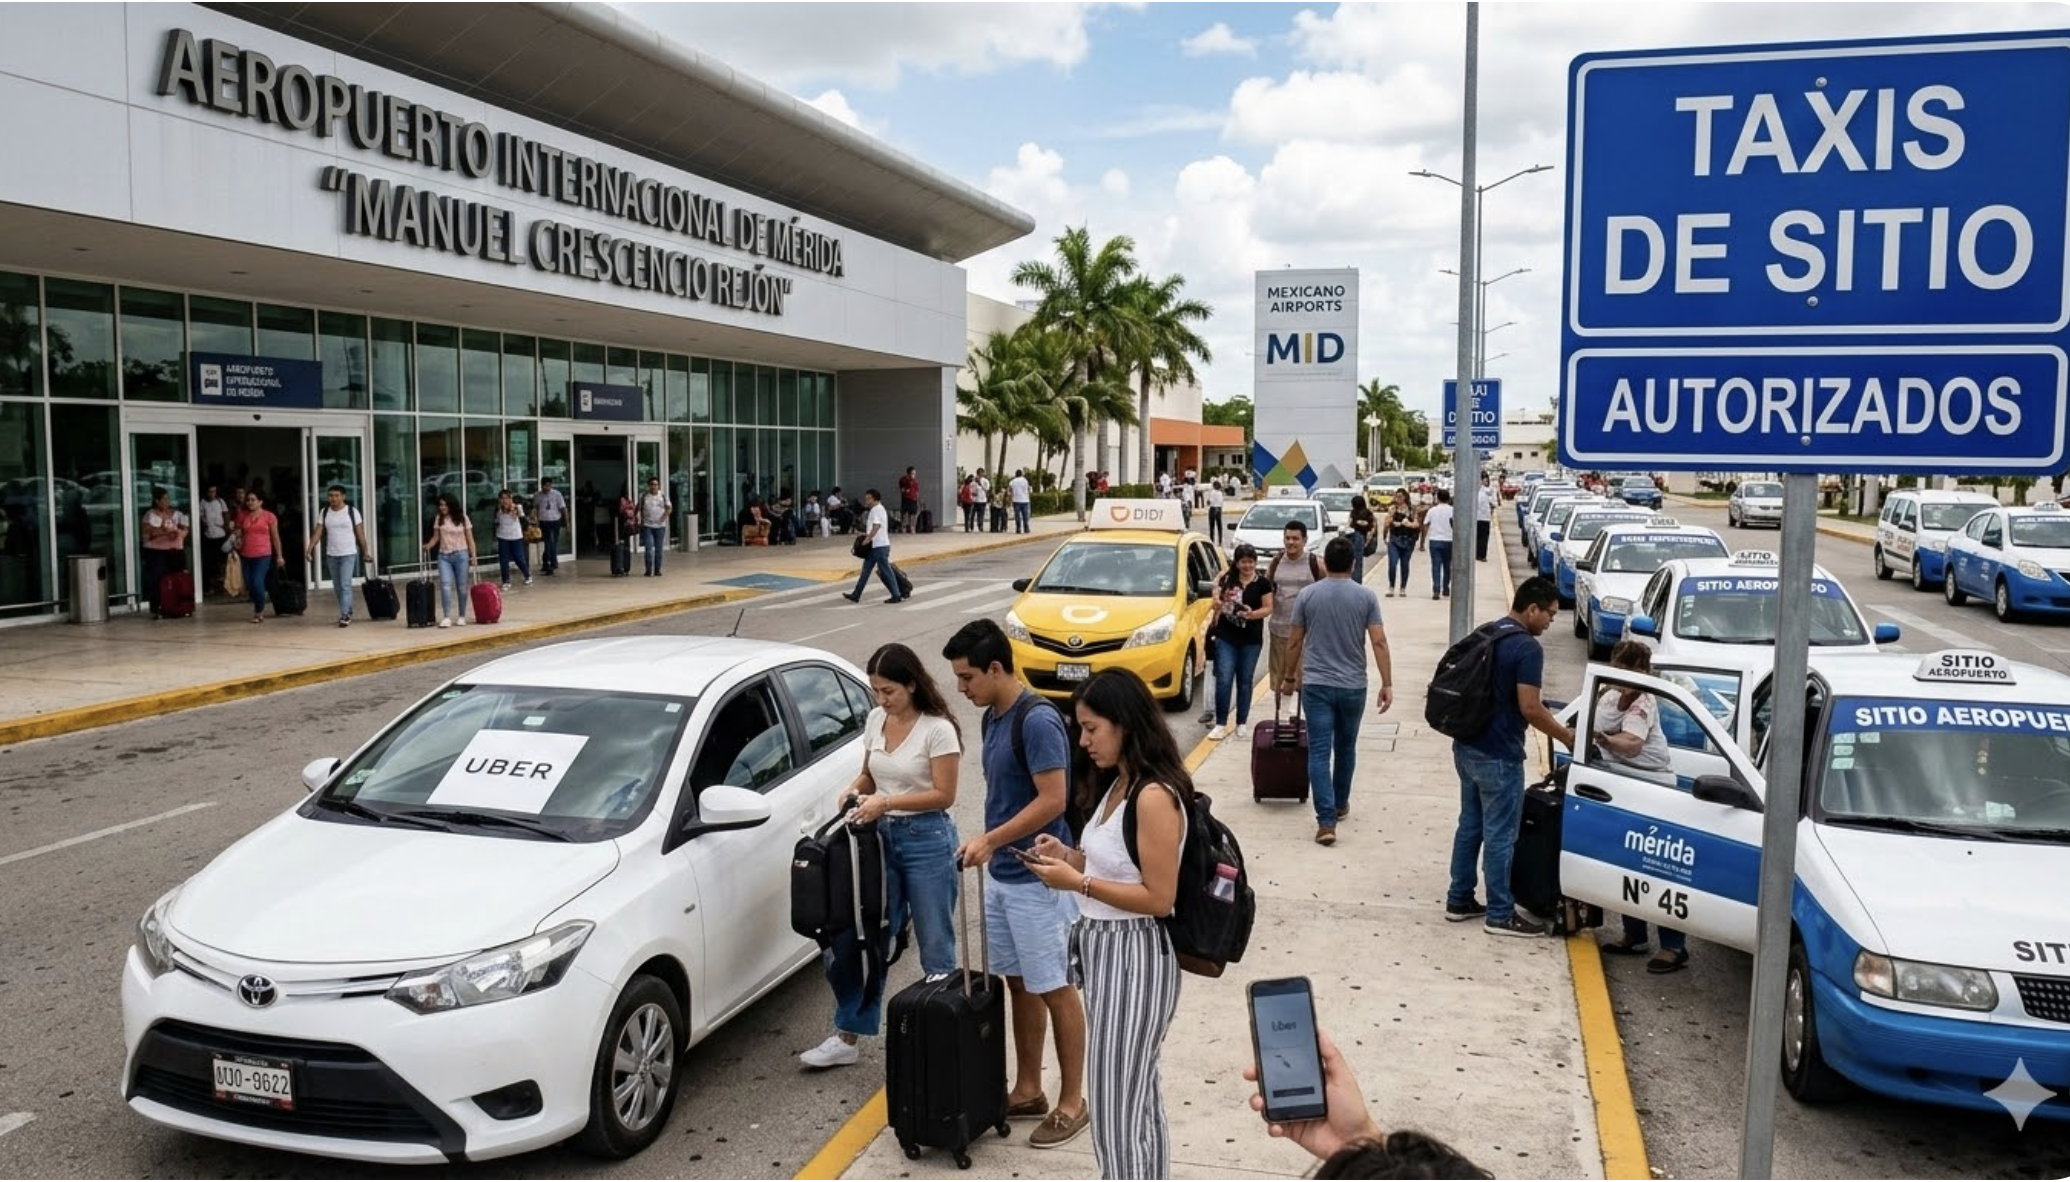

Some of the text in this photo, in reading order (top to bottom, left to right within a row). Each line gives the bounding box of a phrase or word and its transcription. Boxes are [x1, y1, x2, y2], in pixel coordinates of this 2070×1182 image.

[1675, 84, 1967, 177] TAXIS
[156, 28, 844, 276] AEROPUERTO INTERNACIONAL DE MÉRIDA
[529, 219, 712, 301] CRESCENCIO
[1604, 203, 2035, 295] DE SITIO
[1267, 285, 1346, 299] MEXICANO
[1270, 300, 1343, 313] AIRPORTS
[1266, 332, 1345, 365] MID
[1602, 376, 2023, 436] AUTORIZADOS
[1697, 580, 1733, 592] SITIO
[1928, 667, 2008, 679] AEROPUERTO
[1941, 655, 1995, 668] SITIO
[1855, 706, 1928, 727] SITIO
[465, 758, 553, 780] UBER
[1624, 825, 1695, 867] mérida
[1658, 888, 1689, 920] 45
